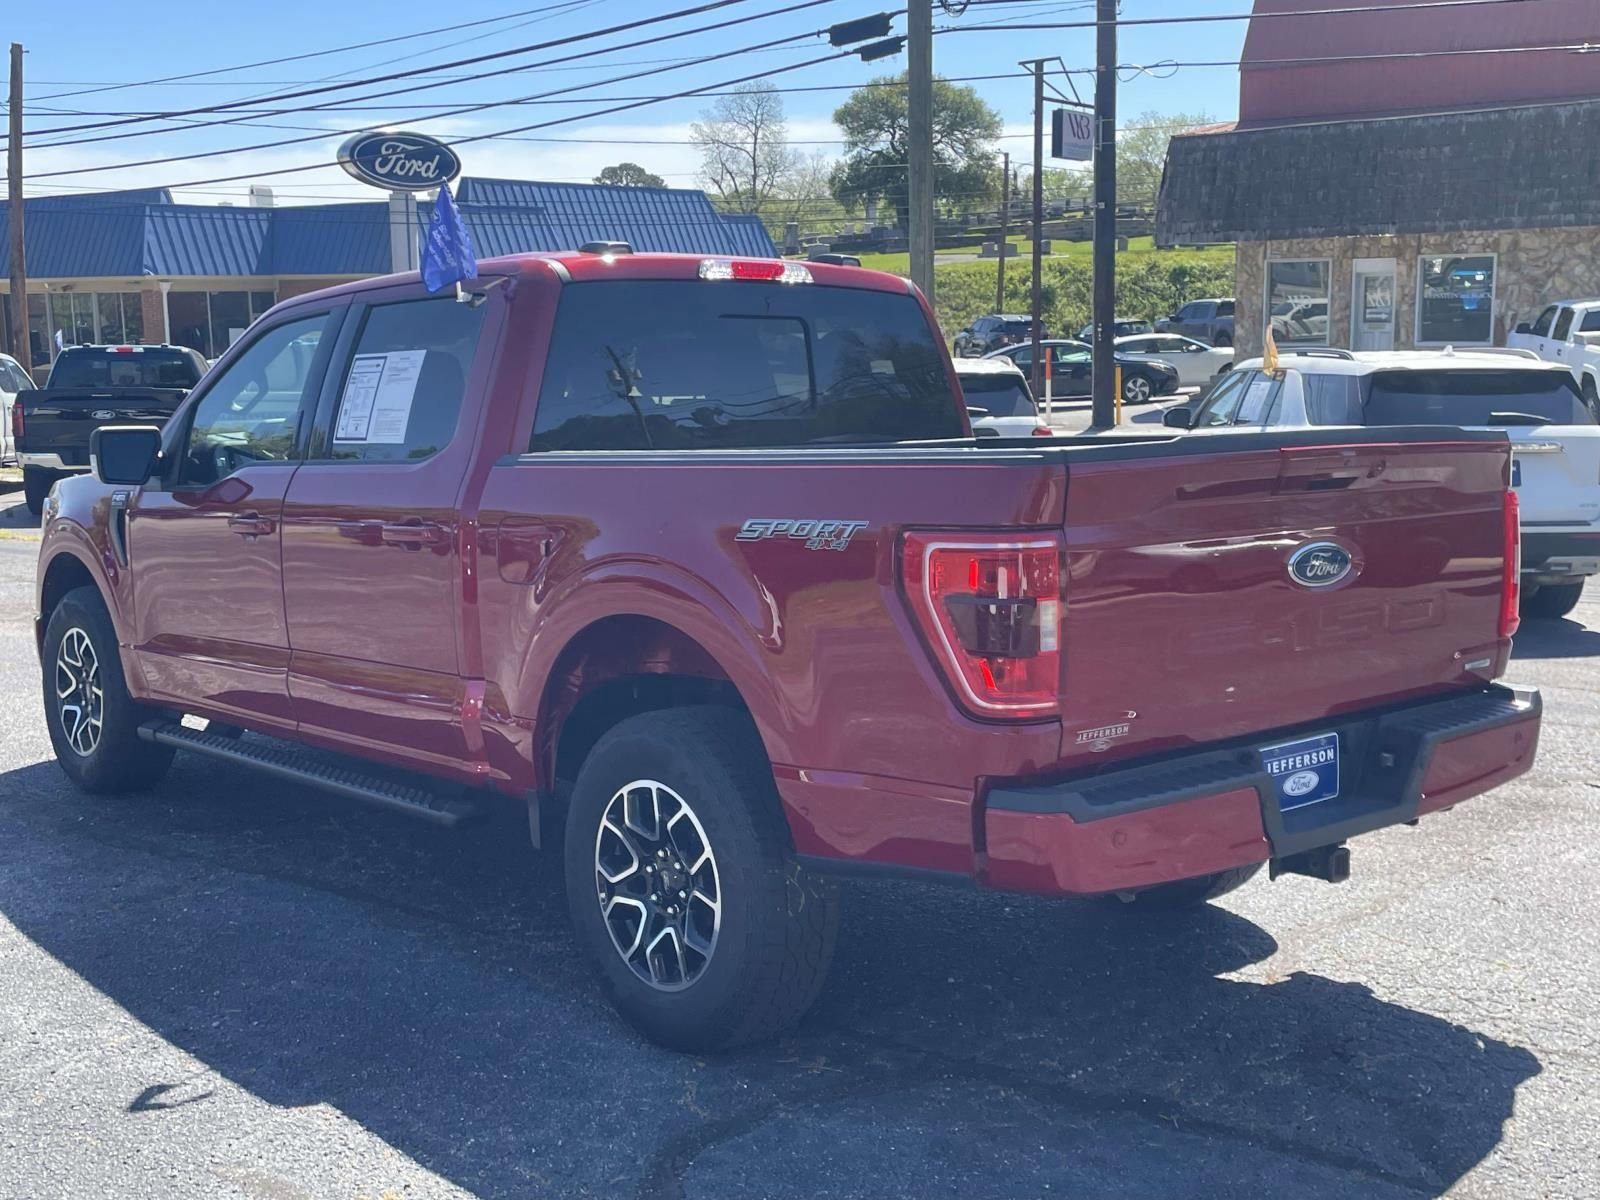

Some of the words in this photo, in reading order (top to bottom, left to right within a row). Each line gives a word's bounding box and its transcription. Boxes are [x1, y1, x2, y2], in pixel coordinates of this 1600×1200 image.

[375, 141, 440, 178] Ford
[735, 518, 869, 542] SPORT
[1306, 552, 1342, 577] Ford
[1077, 725, 1129, 741] JEFFERSON
[1267, 748, 1334, 773] JEFFERSON
[1290, 775, 1312, 792] Ford
